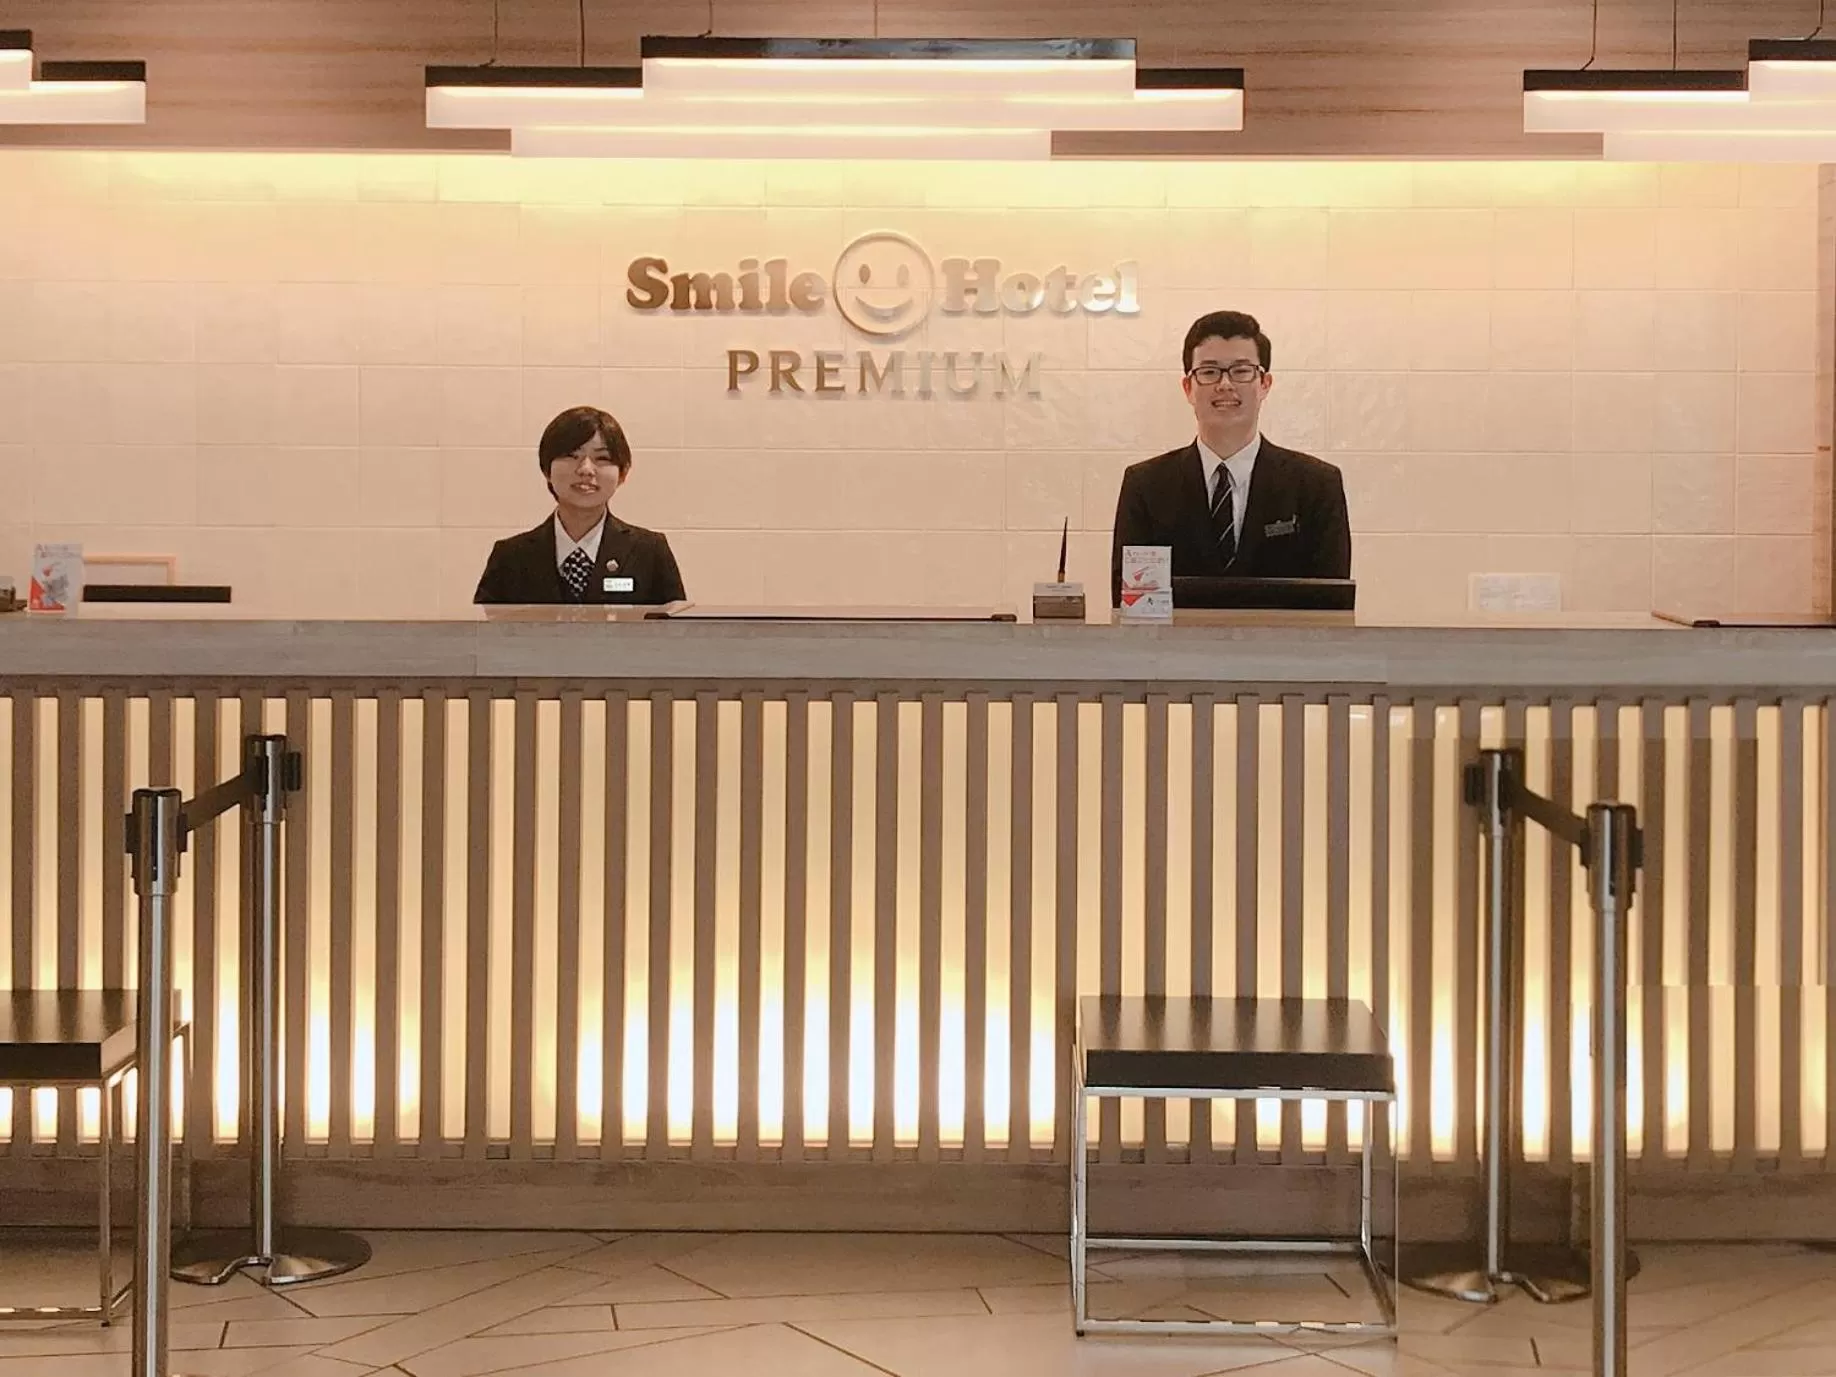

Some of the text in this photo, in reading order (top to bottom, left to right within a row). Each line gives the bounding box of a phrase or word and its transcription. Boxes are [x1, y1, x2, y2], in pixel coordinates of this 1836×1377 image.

[627, 257, 1141, 314] Smile Hotel
[726, 350, 1042, 397] PREMIUM
